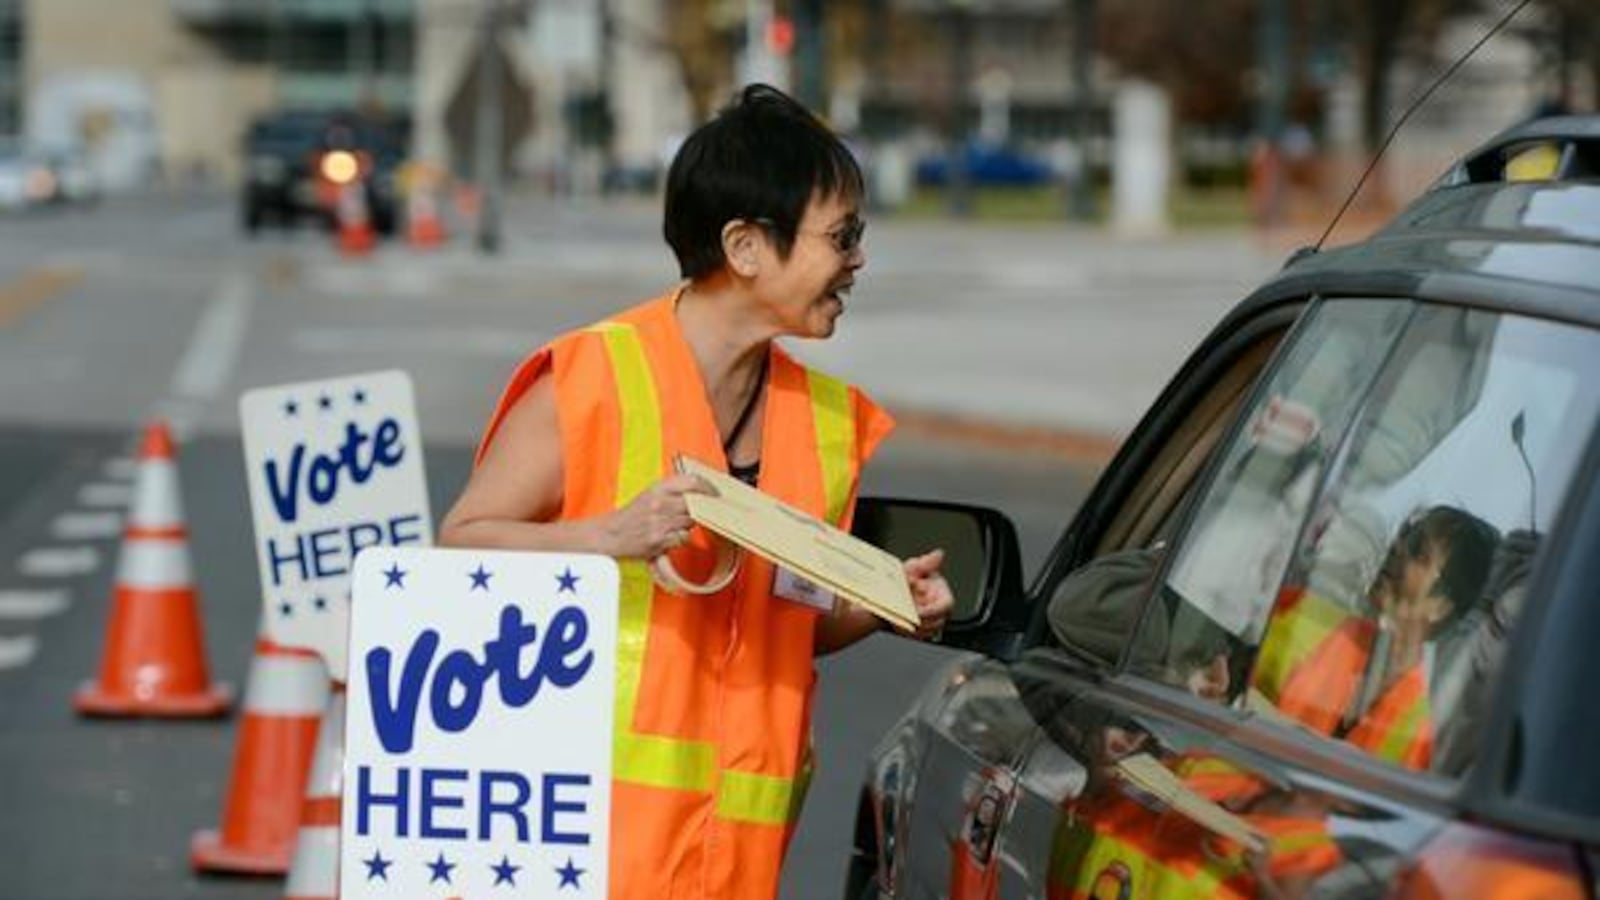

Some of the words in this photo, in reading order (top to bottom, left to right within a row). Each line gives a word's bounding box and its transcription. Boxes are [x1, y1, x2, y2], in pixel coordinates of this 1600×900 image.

[265, 418, 405, 522] Vote
[366, 604, 594, 754] Vote
[356, 766, 591, 845] HERE
